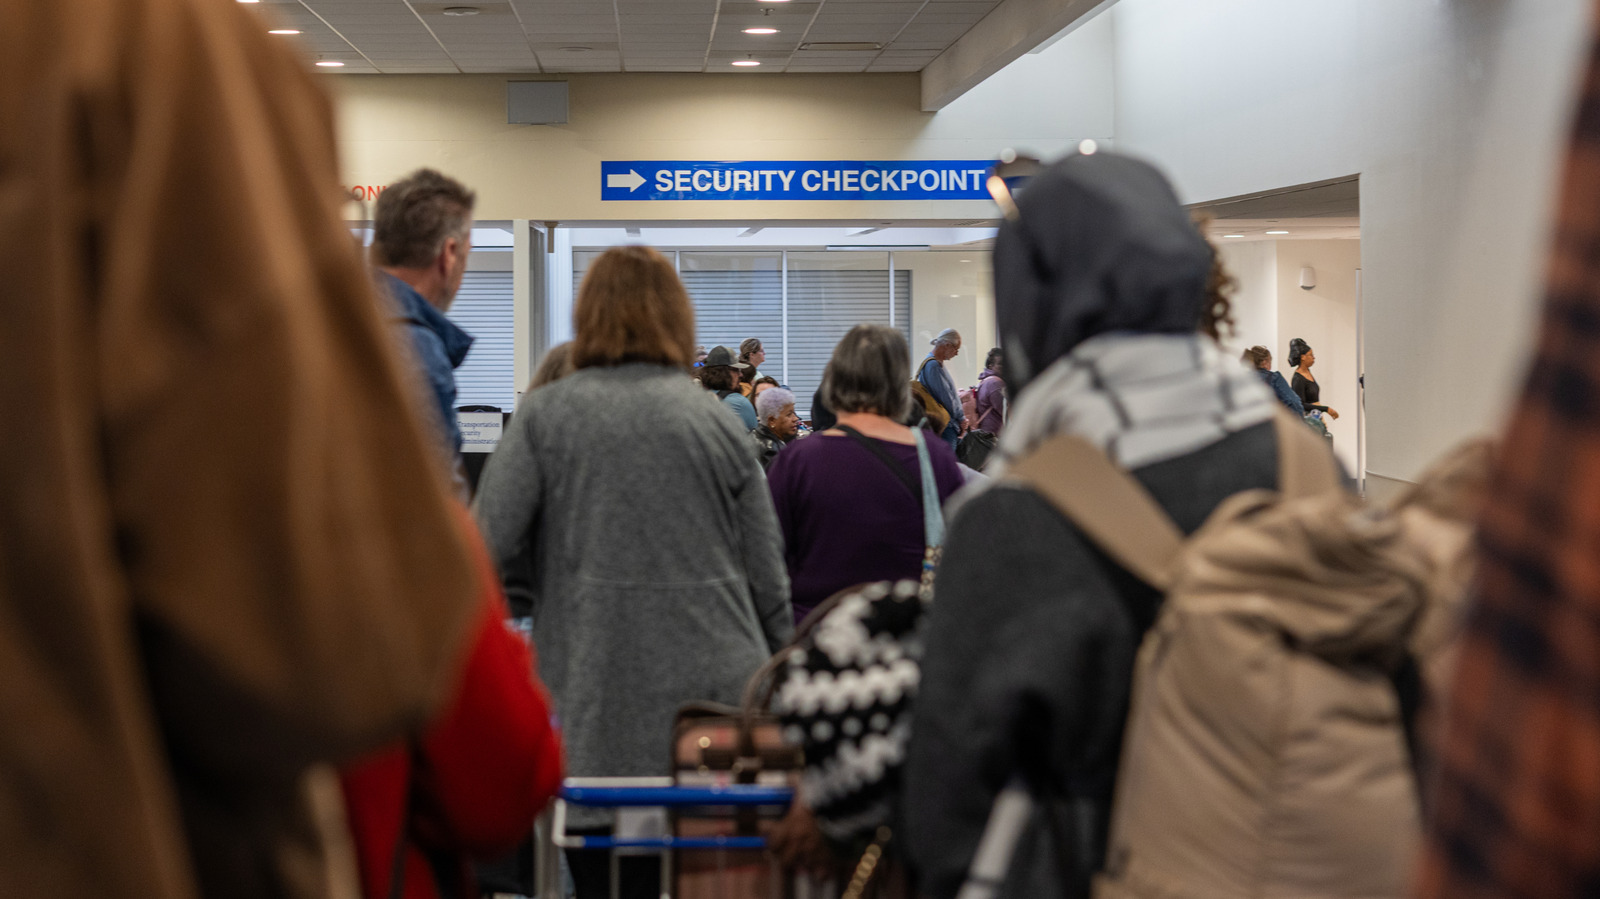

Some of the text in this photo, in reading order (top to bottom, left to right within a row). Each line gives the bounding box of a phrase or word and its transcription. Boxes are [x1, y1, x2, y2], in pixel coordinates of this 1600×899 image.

[655, 169, 986, 192] SECURITY CHECKPOINT
[352, 185, 387, 201] ON
[460, 430, 481, 438] ecurity
[461, 437, 497, 445] dministratio
